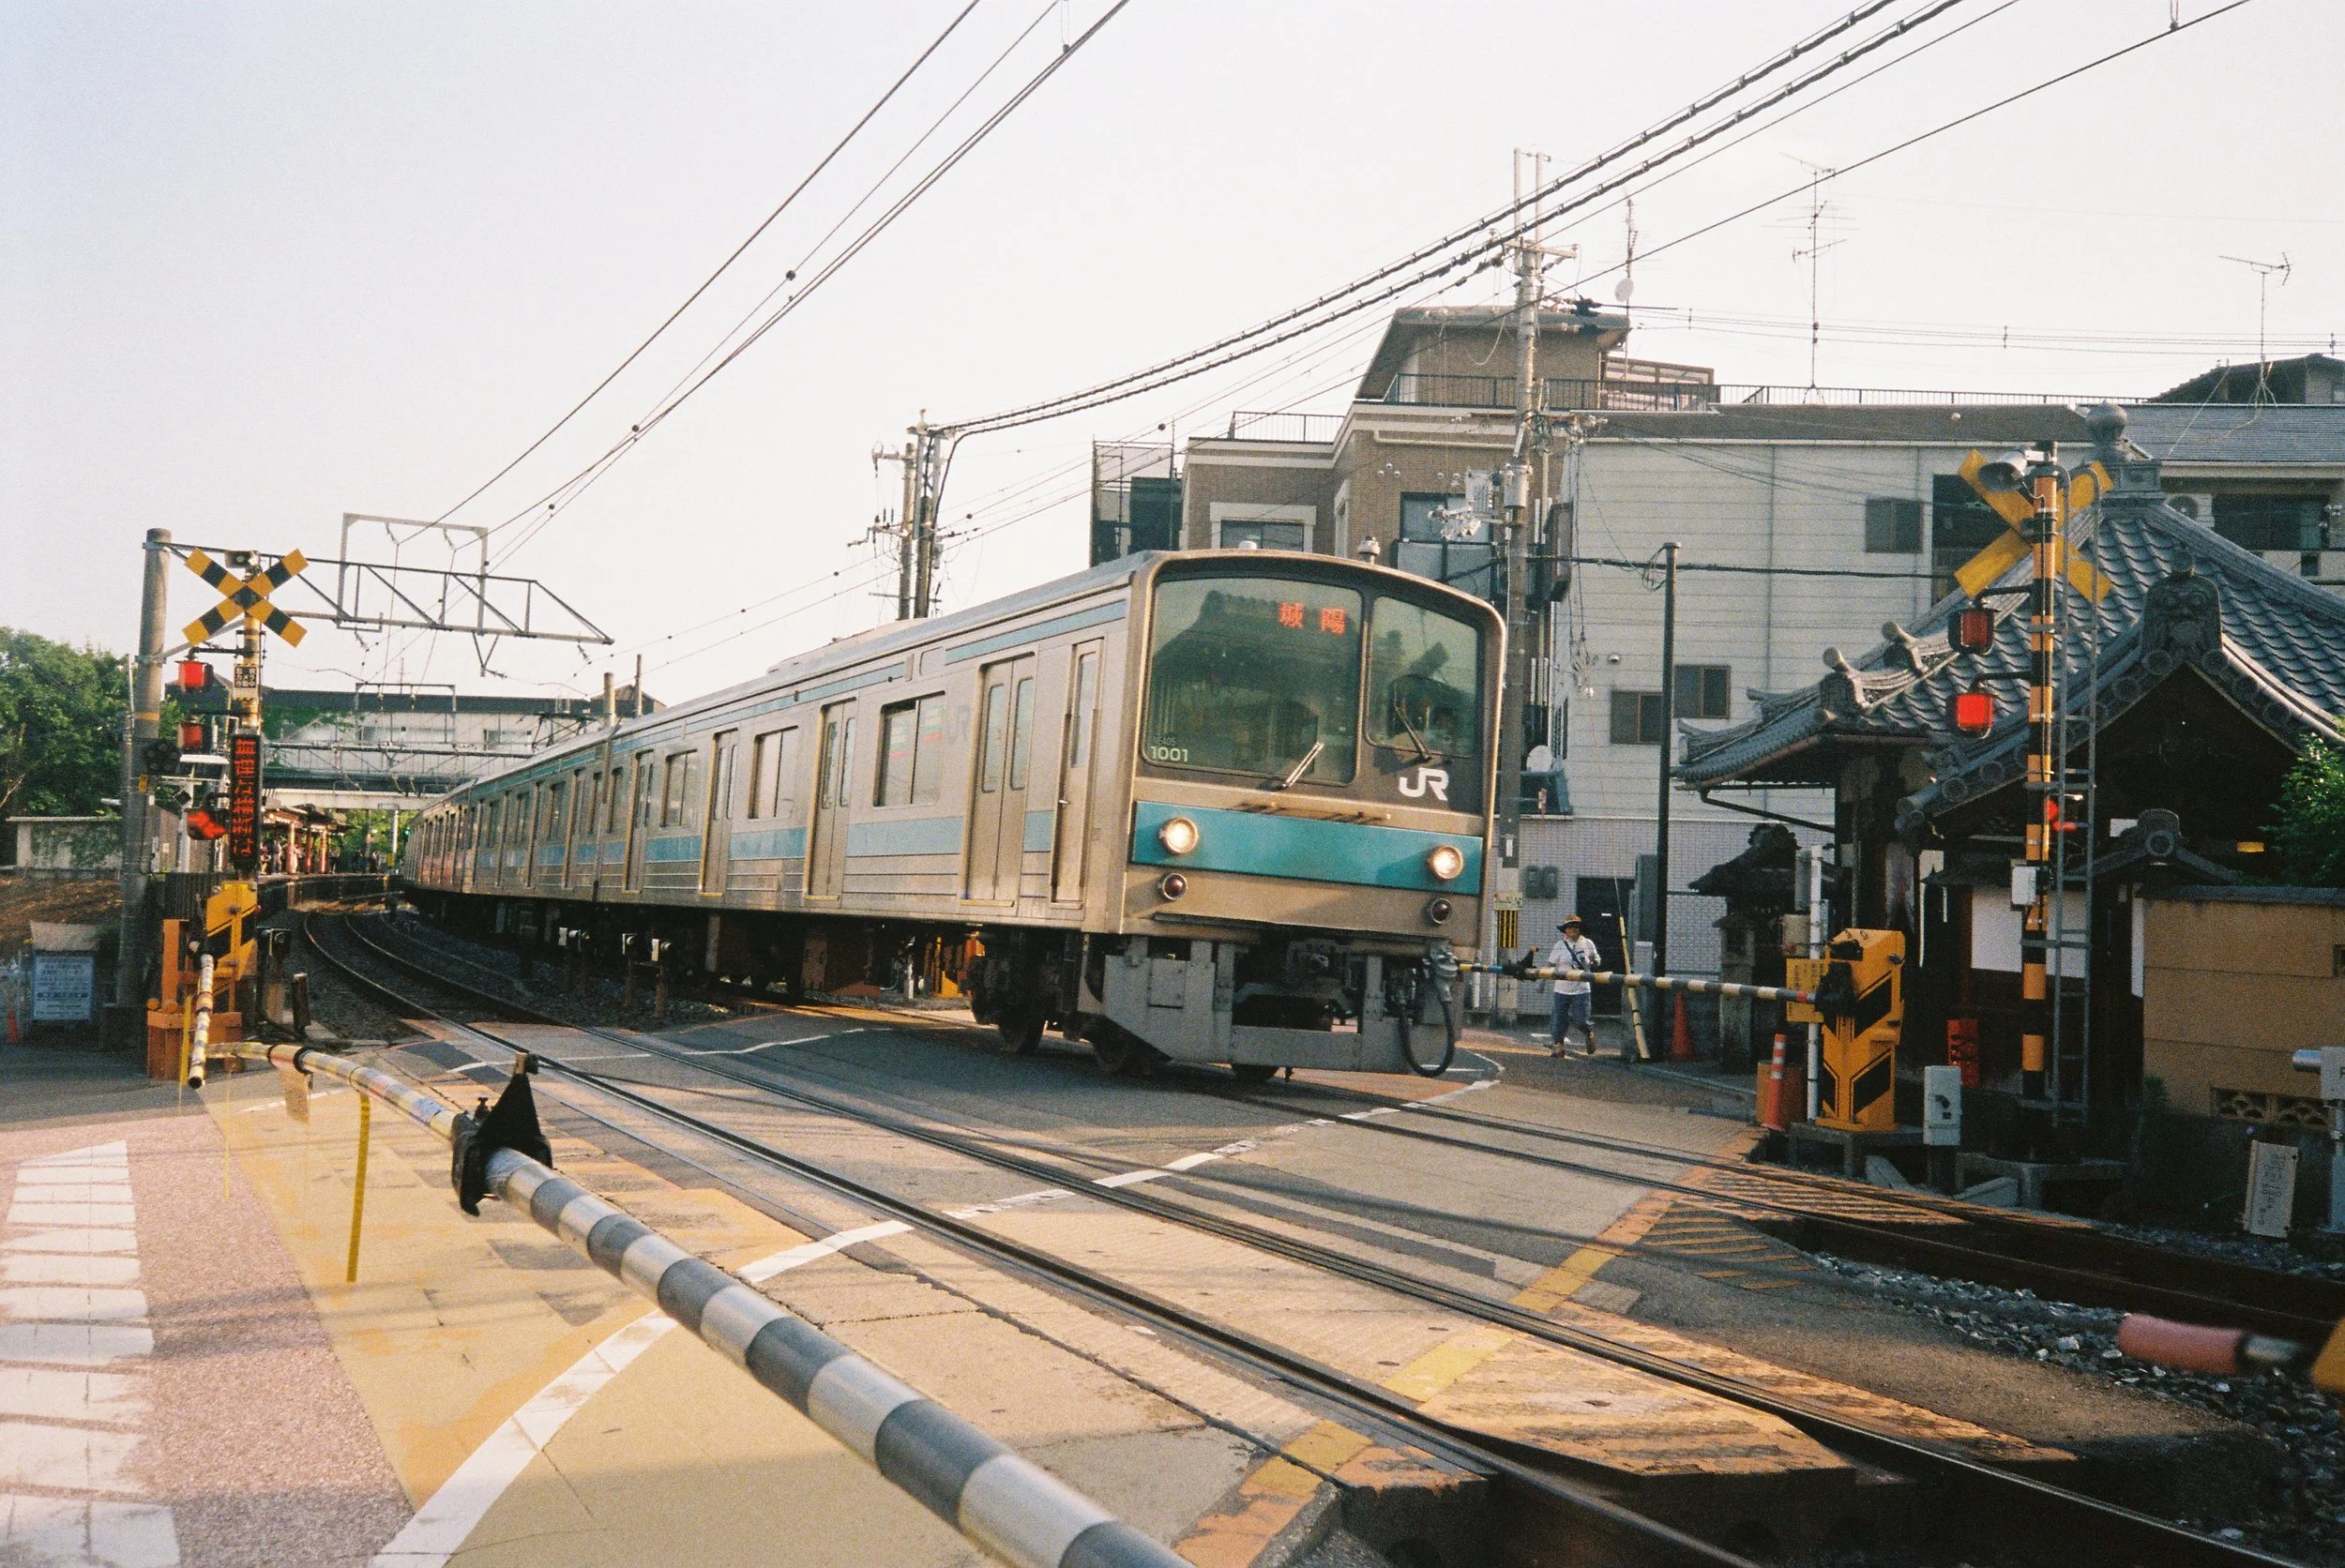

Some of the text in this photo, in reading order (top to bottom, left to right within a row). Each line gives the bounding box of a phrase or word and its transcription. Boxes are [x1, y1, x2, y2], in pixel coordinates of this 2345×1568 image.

[1278, 601, 1345, 635] 城陽
[1150, 746, 1188, 762] 1001
[1399, 766, 1450, 801] JR
